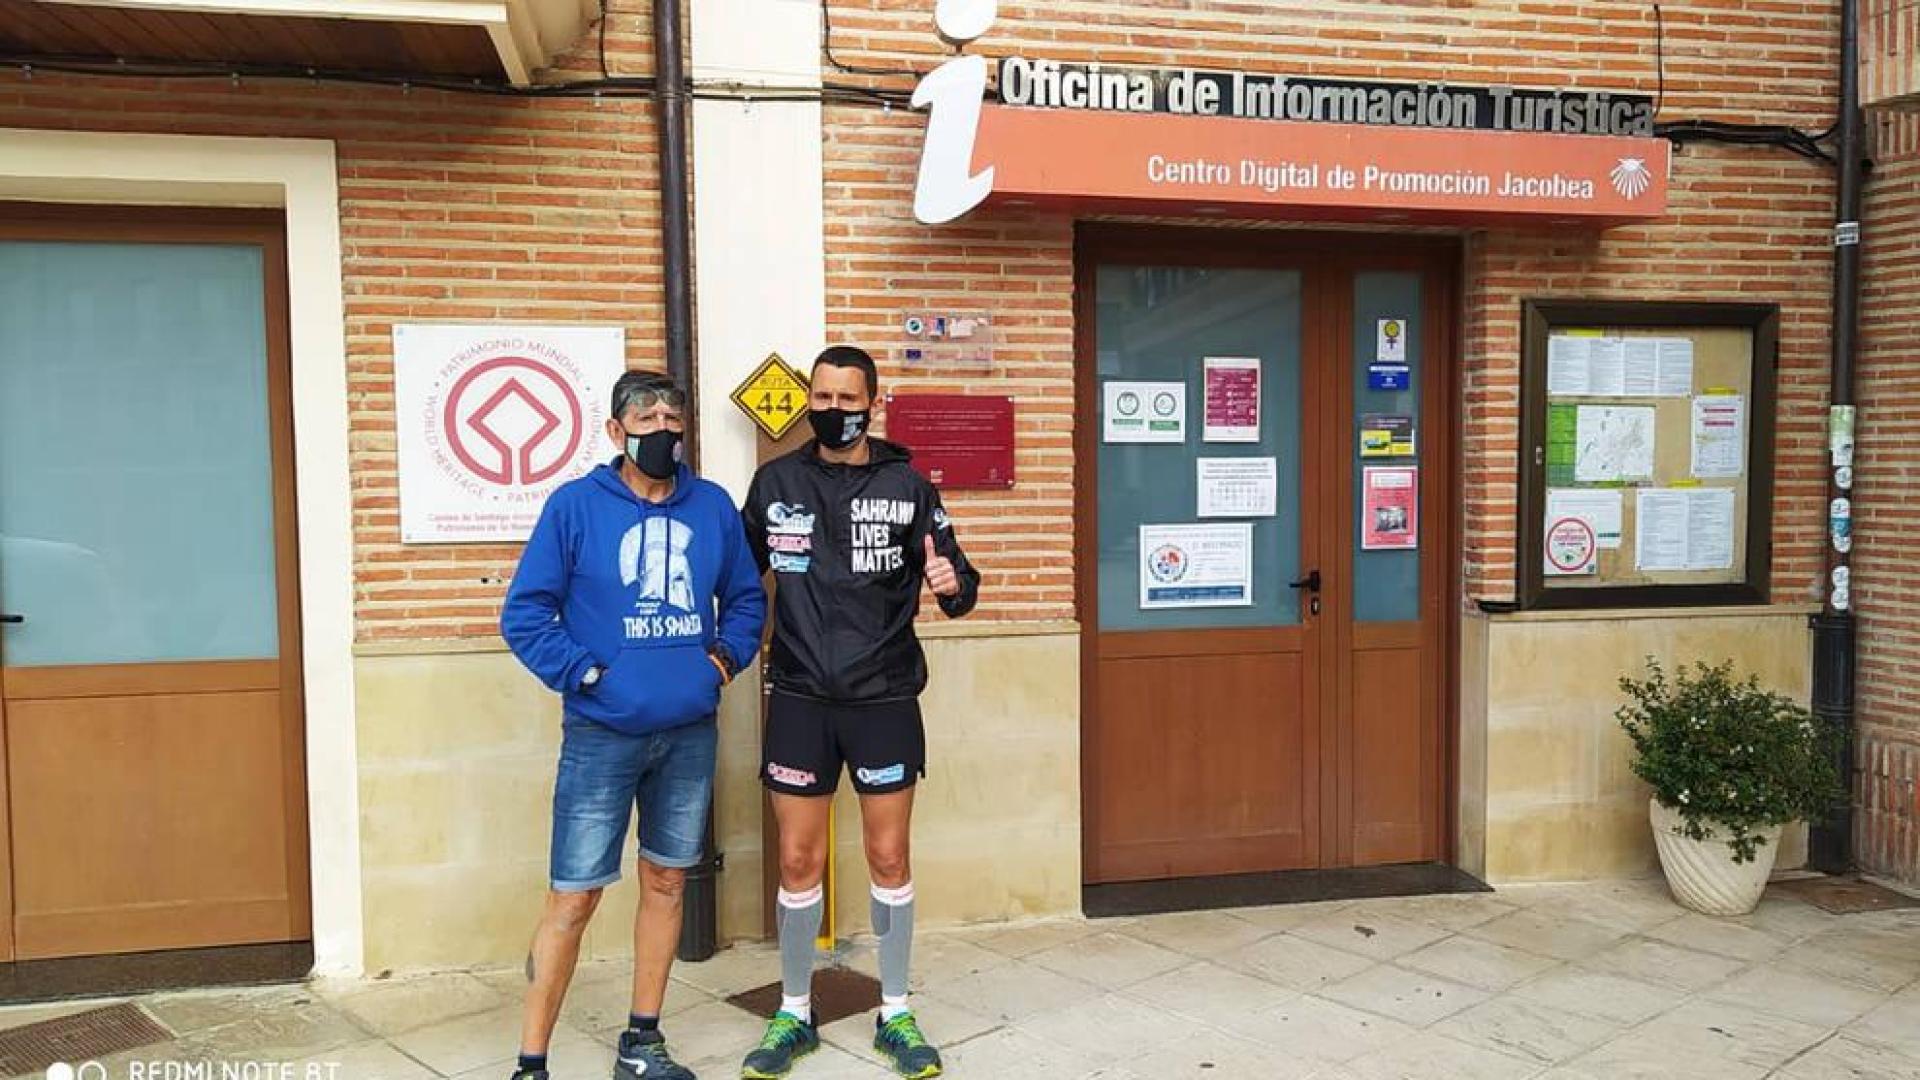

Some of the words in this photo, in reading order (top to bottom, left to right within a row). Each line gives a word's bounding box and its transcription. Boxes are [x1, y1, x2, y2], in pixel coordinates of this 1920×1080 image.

[1001, 56, 1153, 111] Oficina
[1167, 67, 1221, 115] de
[1232, 71, 1476, 130] Información
[1147, 154, 1231, 185] Centro
[1240, 159, 1318, 192] Digital
[1326, 165, 1356, 190] de
[1363, 166, 1490, 195] Promoción
[1497, 171, 1594, 199] Jacobea
[756, 391, 793, 416] 44
[851, 523, 891, 548] LIVES
[622, 616, 651, 638] THIS
[652, 615, 665, 637] IS
